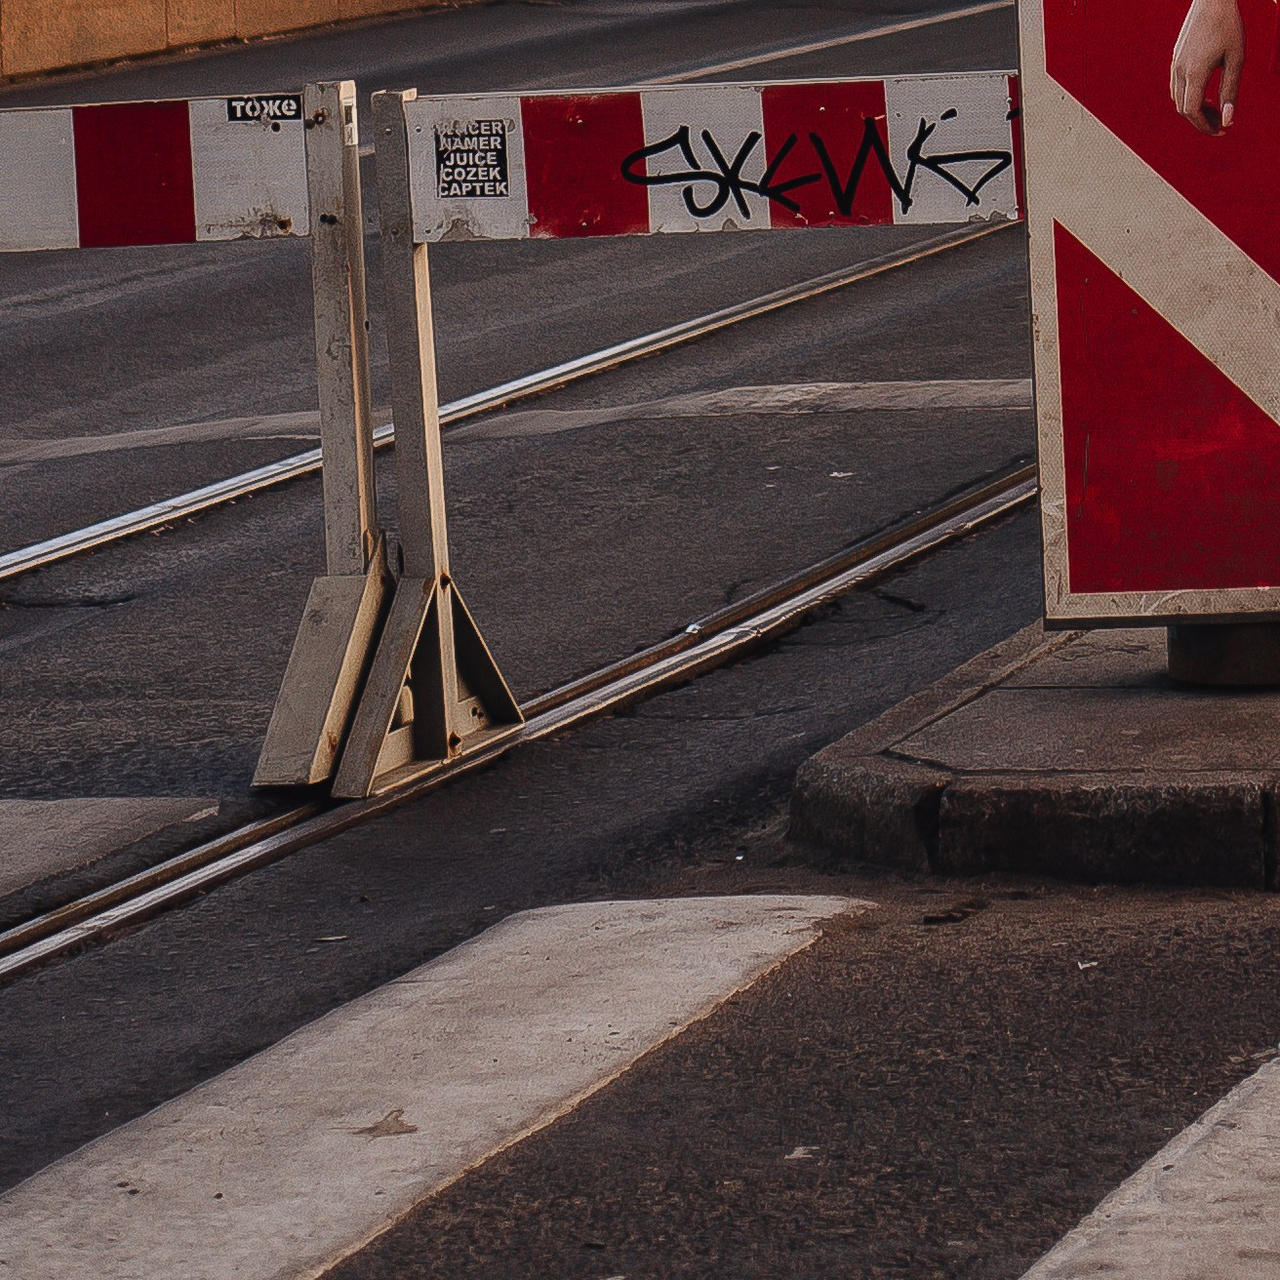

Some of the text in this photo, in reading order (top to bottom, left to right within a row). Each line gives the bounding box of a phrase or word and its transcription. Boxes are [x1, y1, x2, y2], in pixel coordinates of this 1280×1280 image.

[445, 151, 498, 166] JUICE
[442, 167, 502, 182] COZEK
[439, 181, 508, 196] CAPTEK
